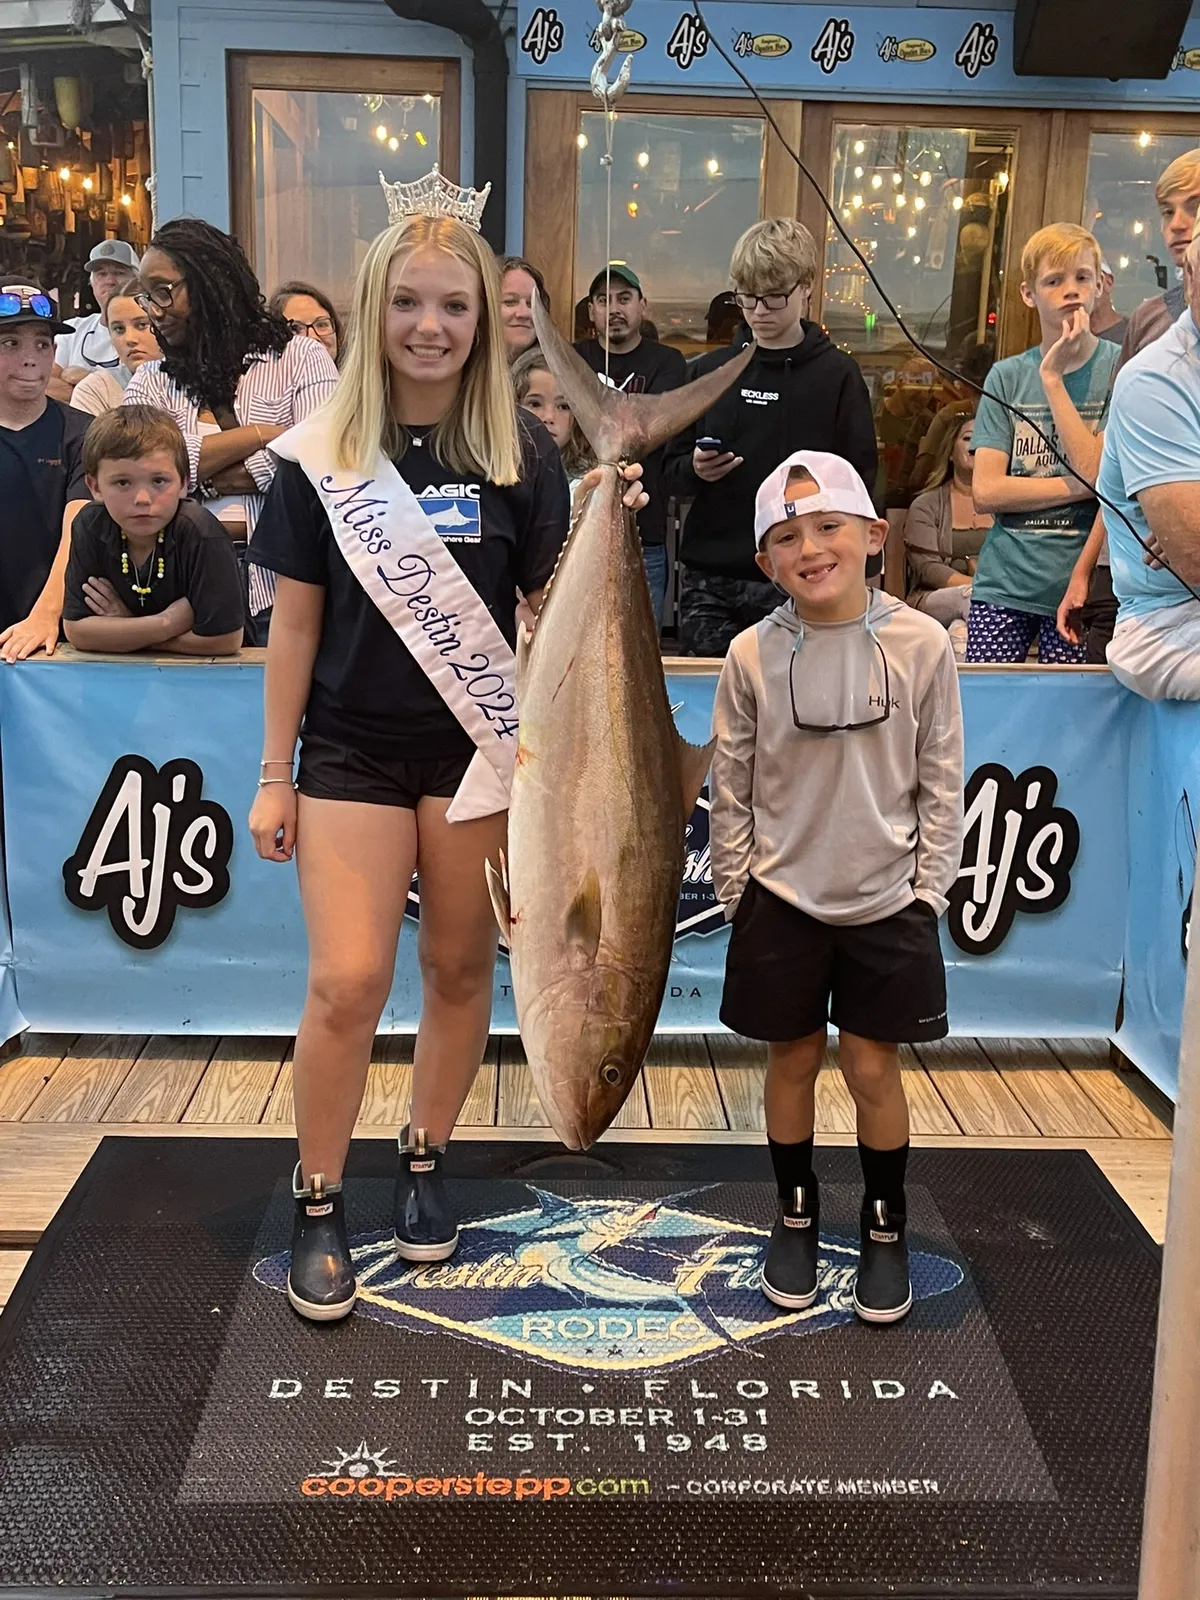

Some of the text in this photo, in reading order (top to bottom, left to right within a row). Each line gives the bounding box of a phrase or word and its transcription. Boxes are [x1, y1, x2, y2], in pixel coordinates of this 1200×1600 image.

[416, 484, 481, 499] AGIC
[320, 475, 520, 740] Miss Destin 2024
[521, 1317, 702, 1341] RODEO
[268, 1378, 959, 1399] DESTIN FLORIDA
[465, 1407, 768, 1426] OCTOBER 1-31
[467, 1433, 768, 1453] EST. 1948
[301, 1472, 649, 1501] cooperstepp.com
[686, 1479, 832, 1495] CORPORATE
[837, 1478, 940, 1494] MEMBER
